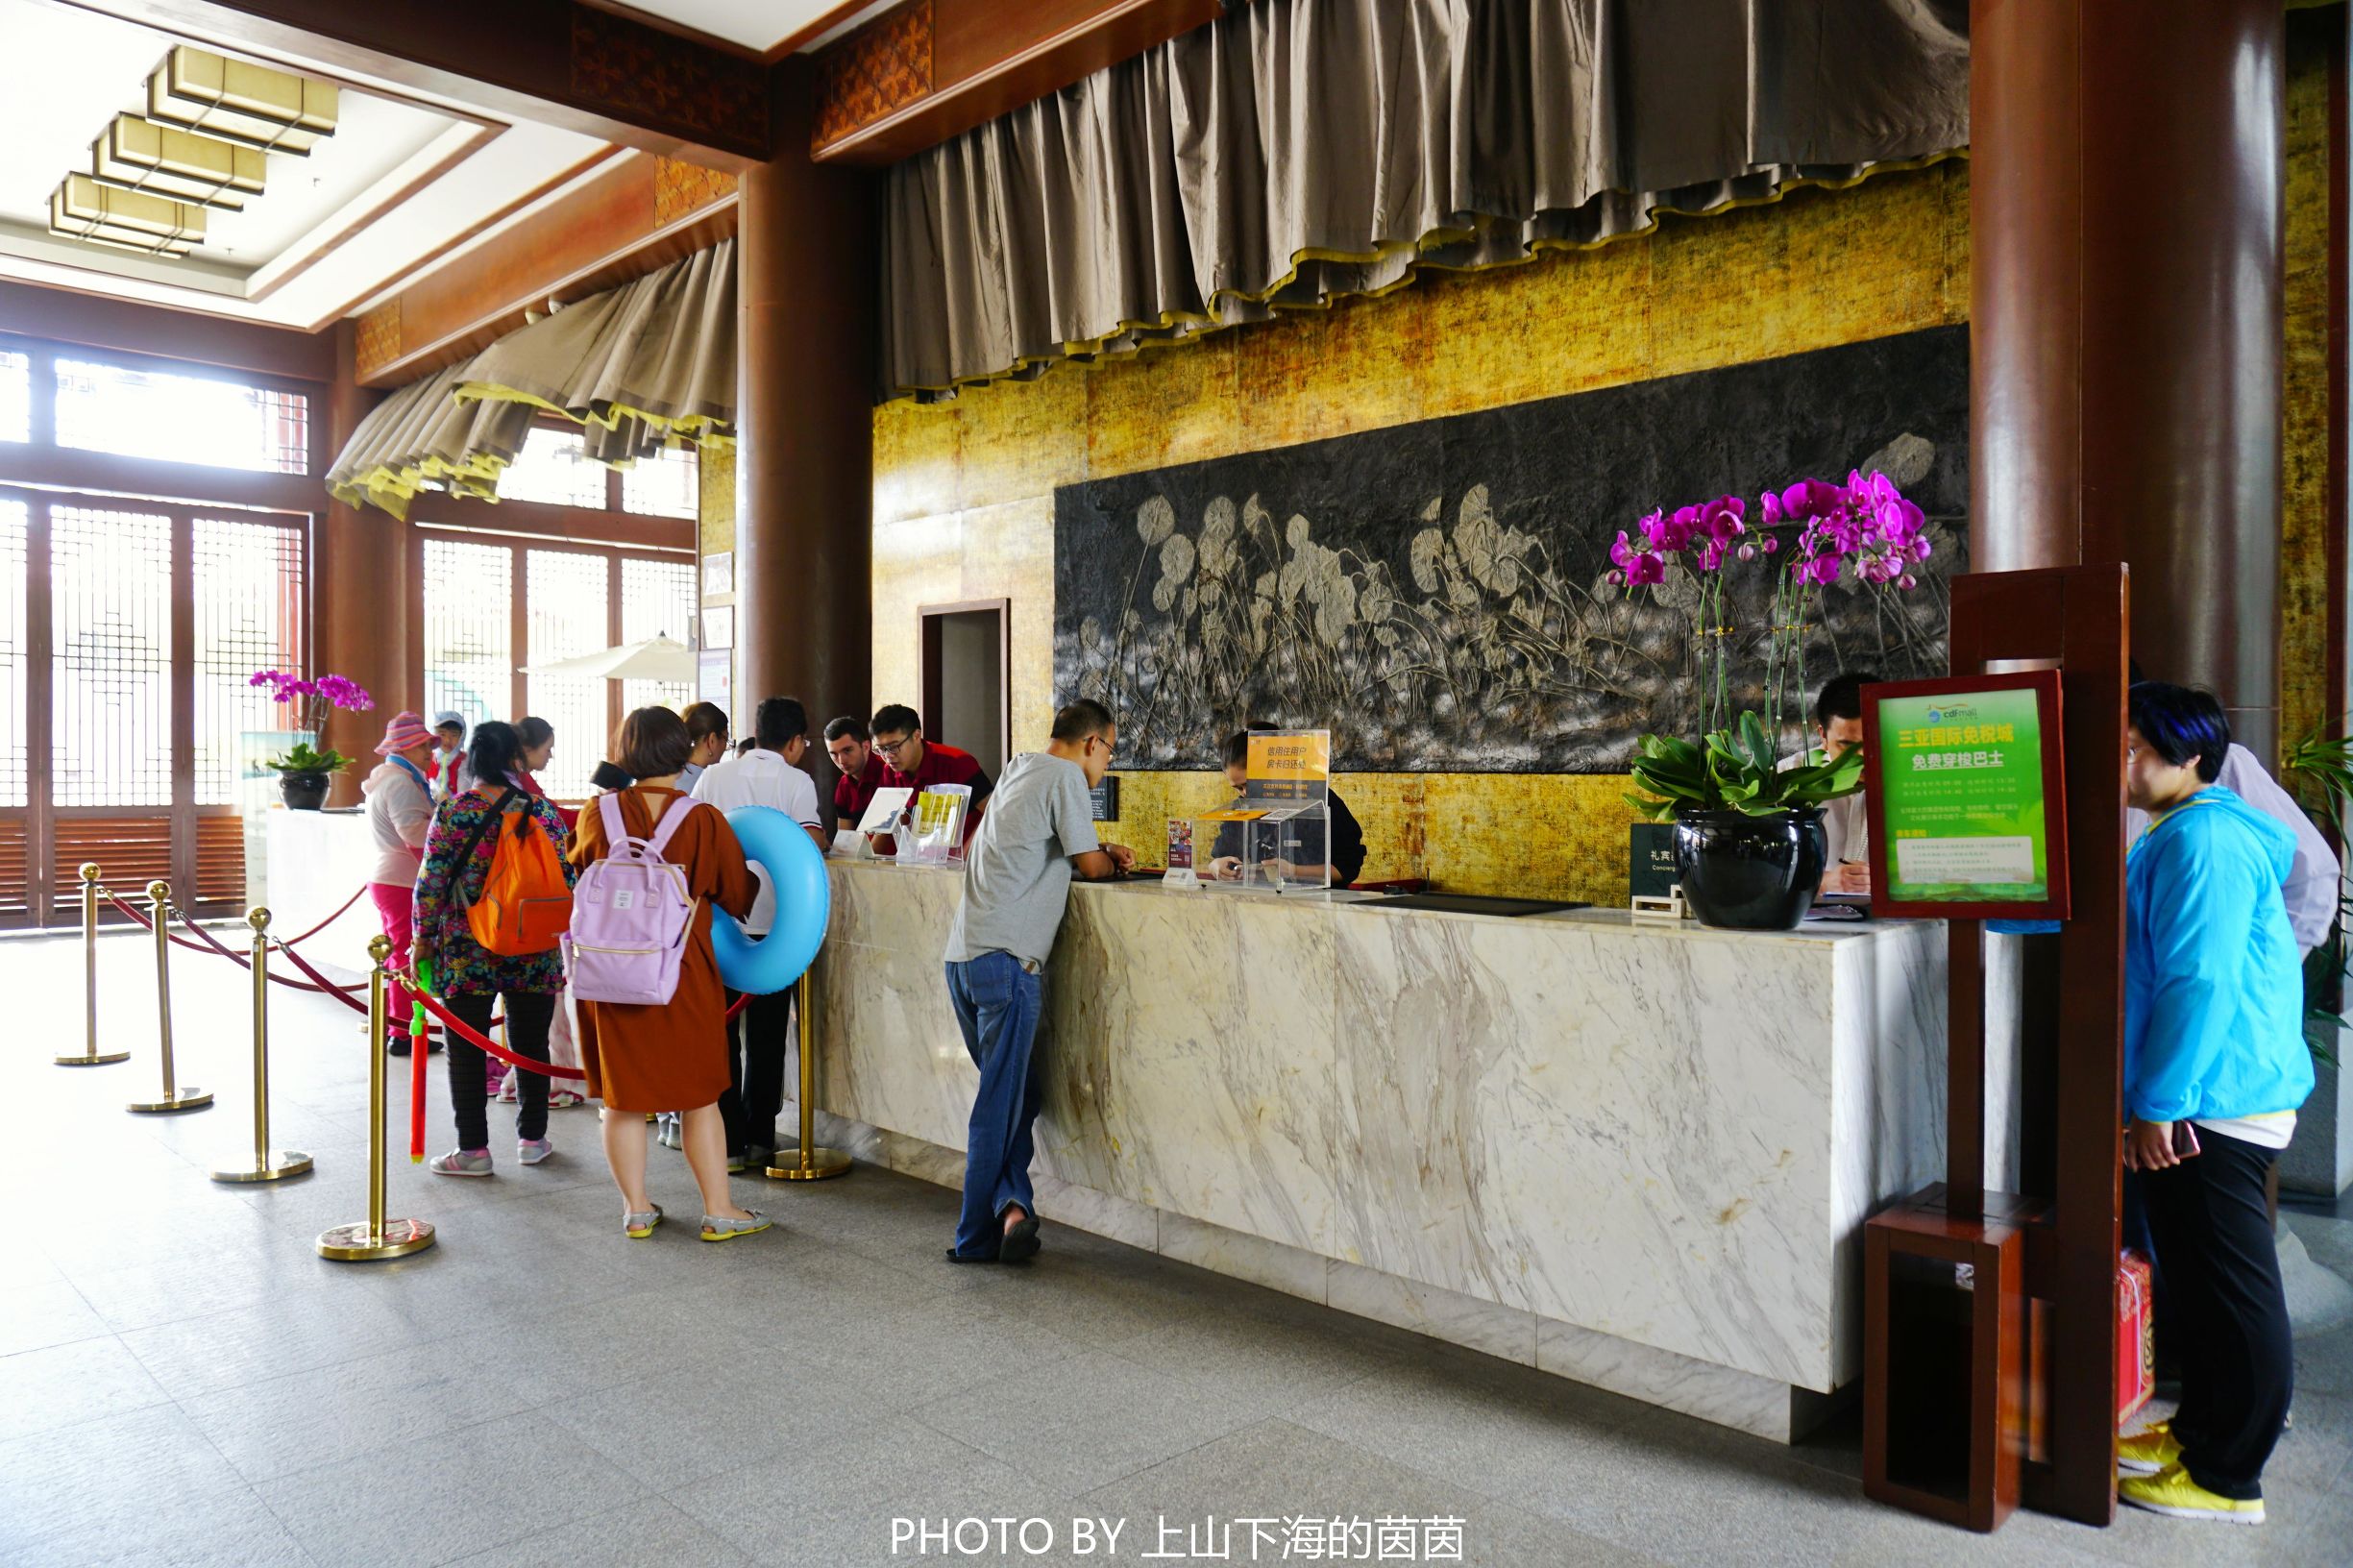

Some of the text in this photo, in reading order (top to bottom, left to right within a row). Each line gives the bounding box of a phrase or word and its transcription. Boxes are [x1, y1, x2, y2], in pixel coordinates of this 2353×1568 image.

[1899, 723, 2014, 747] 三亚国际免税城
[1267, 747, 1307, 756] 信用住用户
[1912, 750, 2004, 770] 免费穿梭巴士
